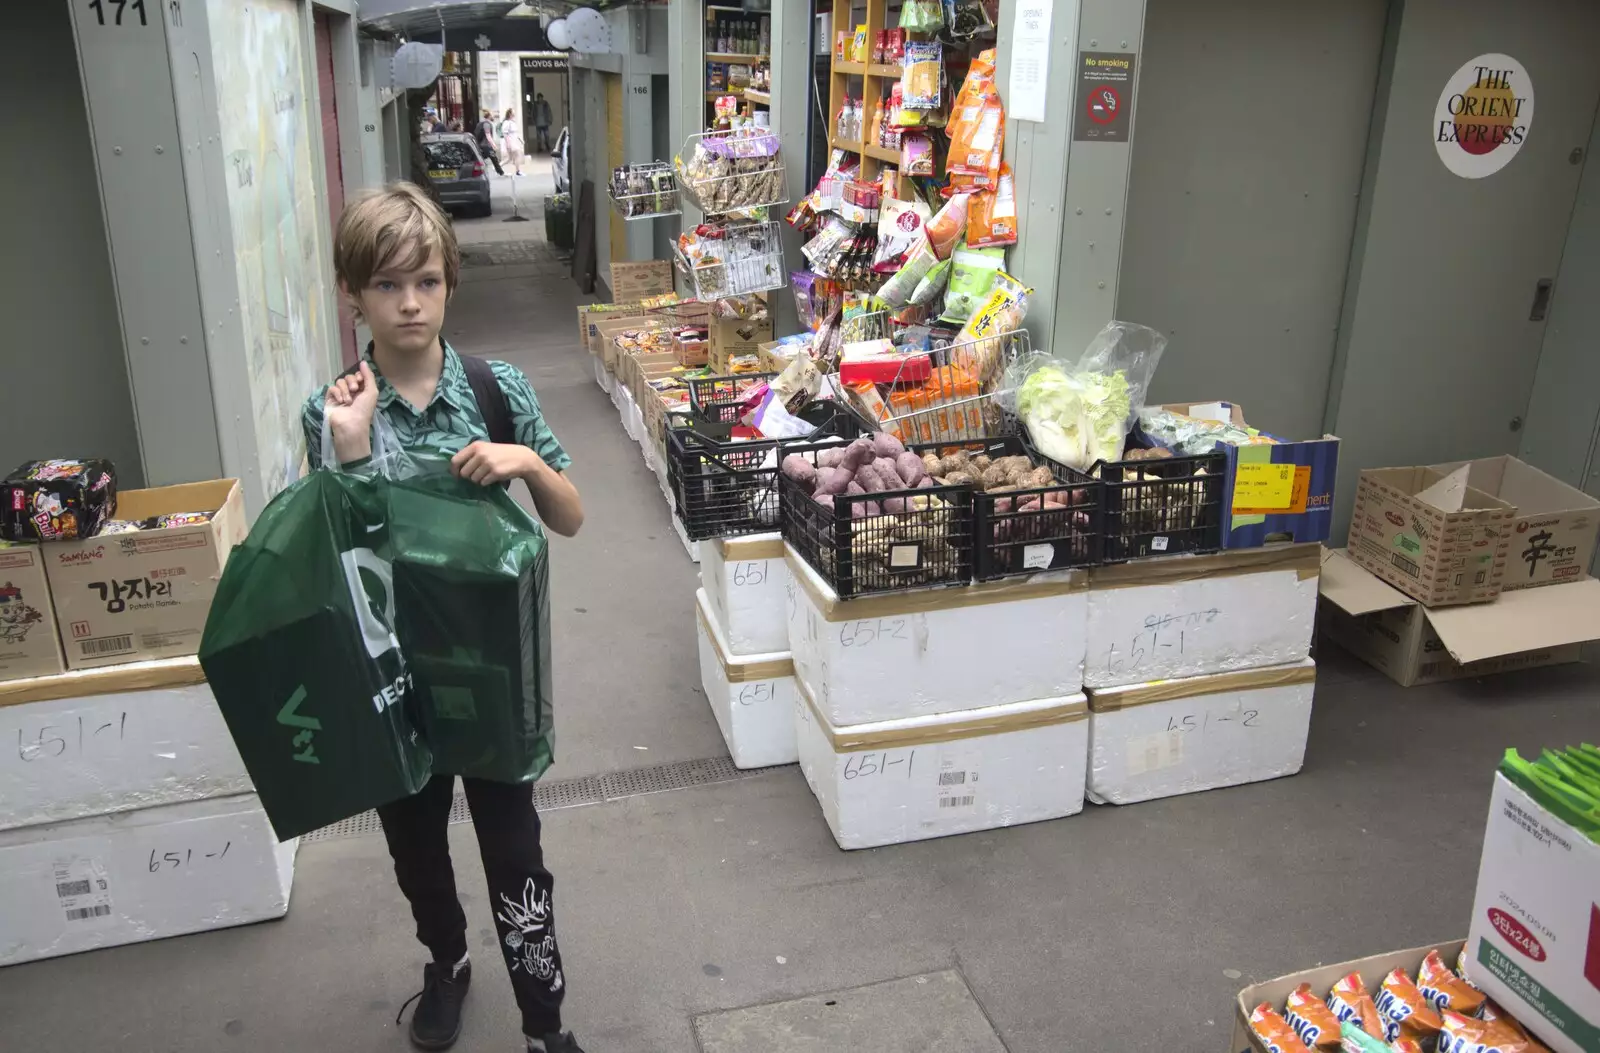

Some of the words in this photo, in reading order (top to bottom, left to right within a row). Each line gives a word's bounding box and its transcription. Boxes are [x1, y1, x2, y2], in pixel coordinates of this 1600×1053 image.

[88, 0, 148, 26] 171
[523, 60, 552, 68] LLOYDS
[1085, 58, 1096, 66] No
[1098, 59, 1129, 69] smoking
[633, 86, 648, 94] 166
[1473, 66, 1514, 90] THE
[1447, 93, 1527, 119] ORIENT
[1437, 120, 1526, 145] EXPRESS
[59, 545, 105, 562] SAMYANG
[1521, 529, 1557, 577] 辛
[733, 560, 768, 586] 651
[129, 602, 154, 611] Potato
[840, 619, 908, 647] 651-2
[1108, 630, 1184, 676] 651-1
[739, 682, 774, 706] 651
[19, 711, 126, 762] 651-1
[844, 750, 914, 780] 651-1
[149, 841, 231, 873] 651-1
